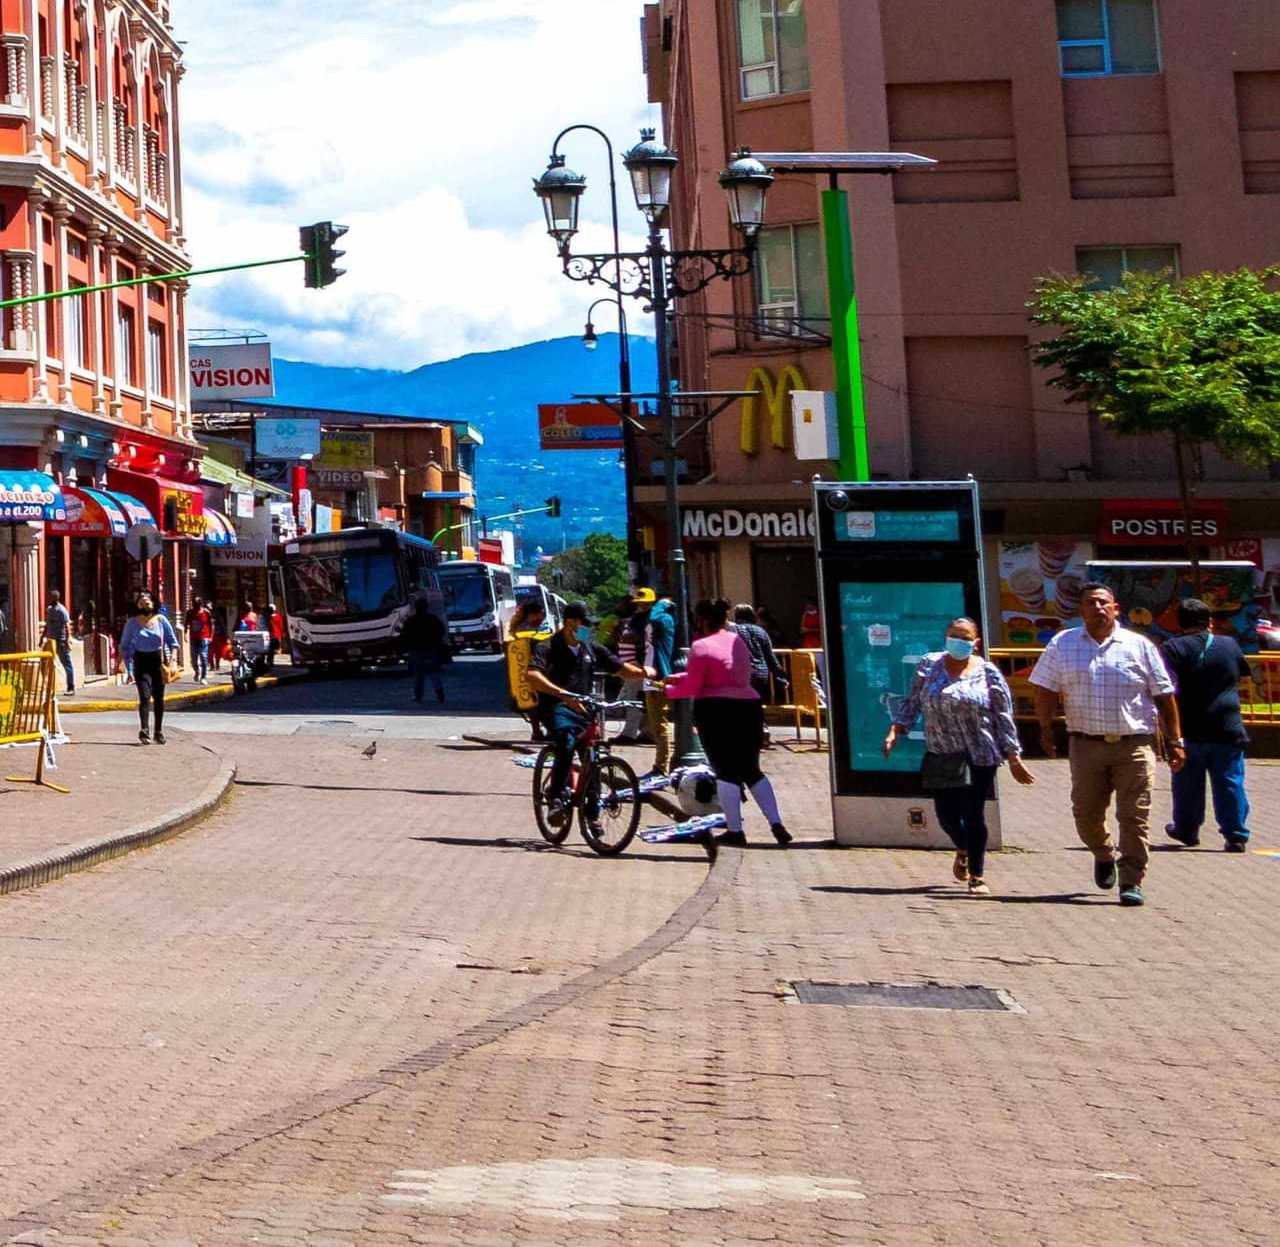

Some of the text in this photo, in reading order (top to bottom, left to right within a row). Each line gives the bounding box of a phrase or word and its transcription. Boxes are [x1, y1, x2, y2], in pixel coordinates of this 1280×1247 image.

[191, 368, 271, 387] VISION
[317, 472, 362, 483] VIDEO
[1111, 519, 1218, 535] POSTRES
[224, 551, 264, 560] VISION
